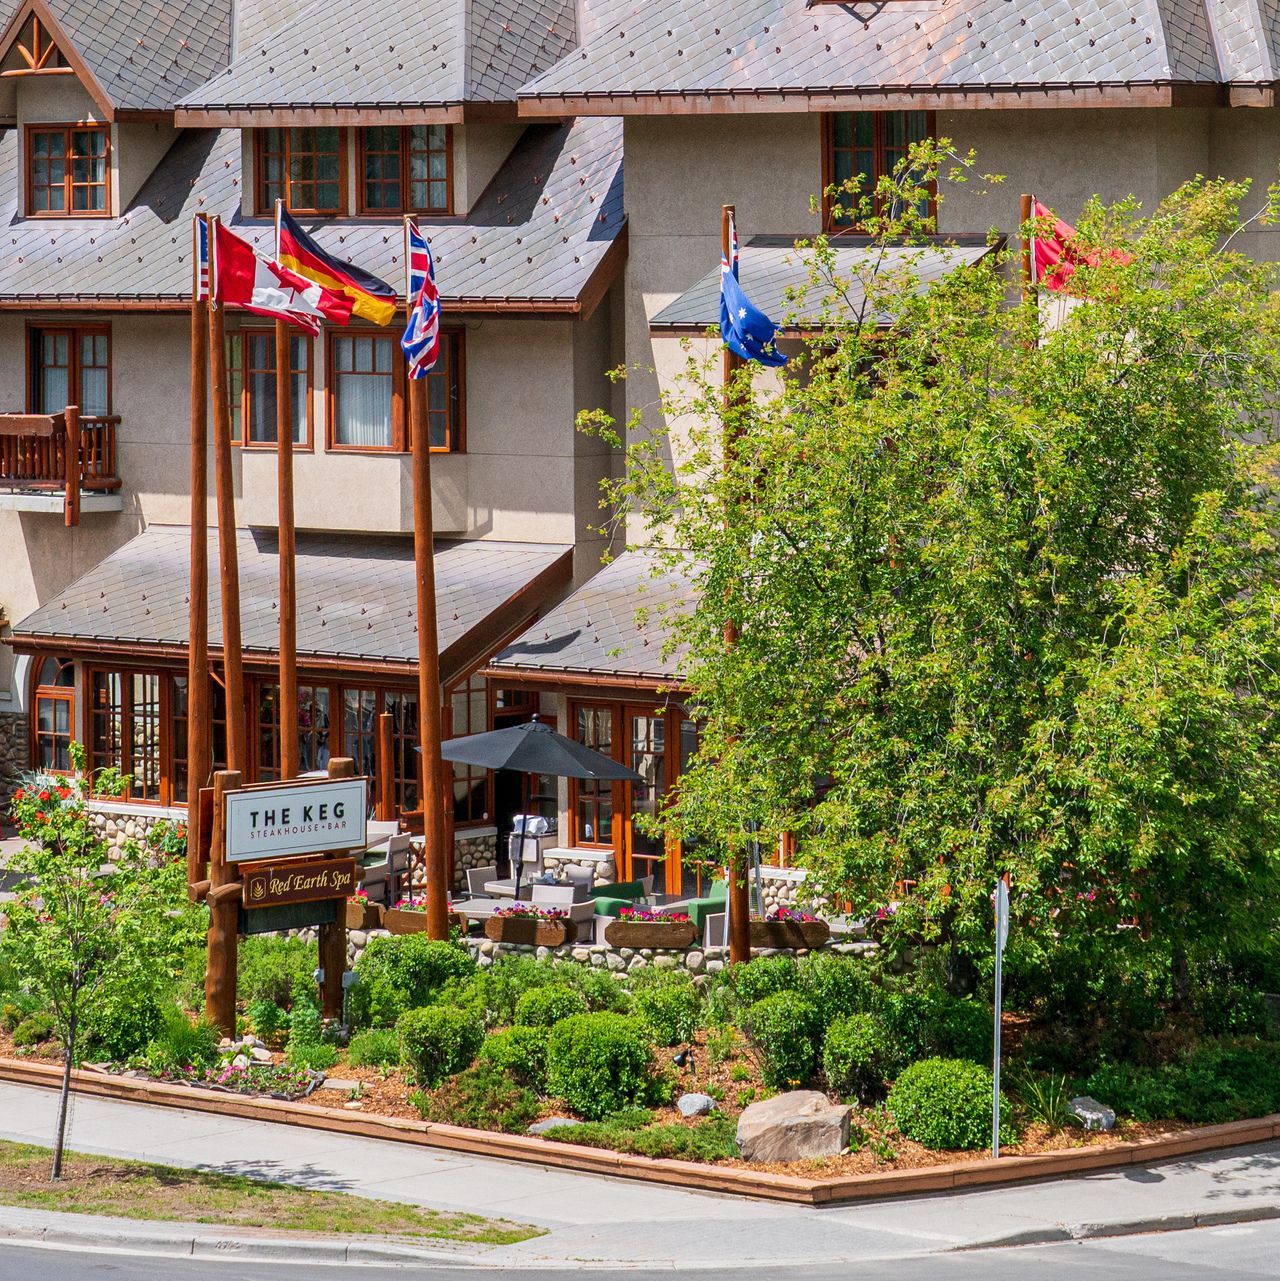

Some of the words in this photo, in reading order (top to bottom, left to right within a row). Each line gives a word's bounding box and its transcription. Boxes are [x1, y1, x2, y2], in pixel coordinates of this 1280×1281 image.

[250, 808, 290, 828] THE
[303, 802, 345, 822] KEG
[250, 823, 319, 839] STEAKHOUSE
[327, 821, 347, 830] BAR
[269, 874, 294, 896] Red
[293, 870, 328, 890] Earth
[330, 870, 351, 890] Spa
